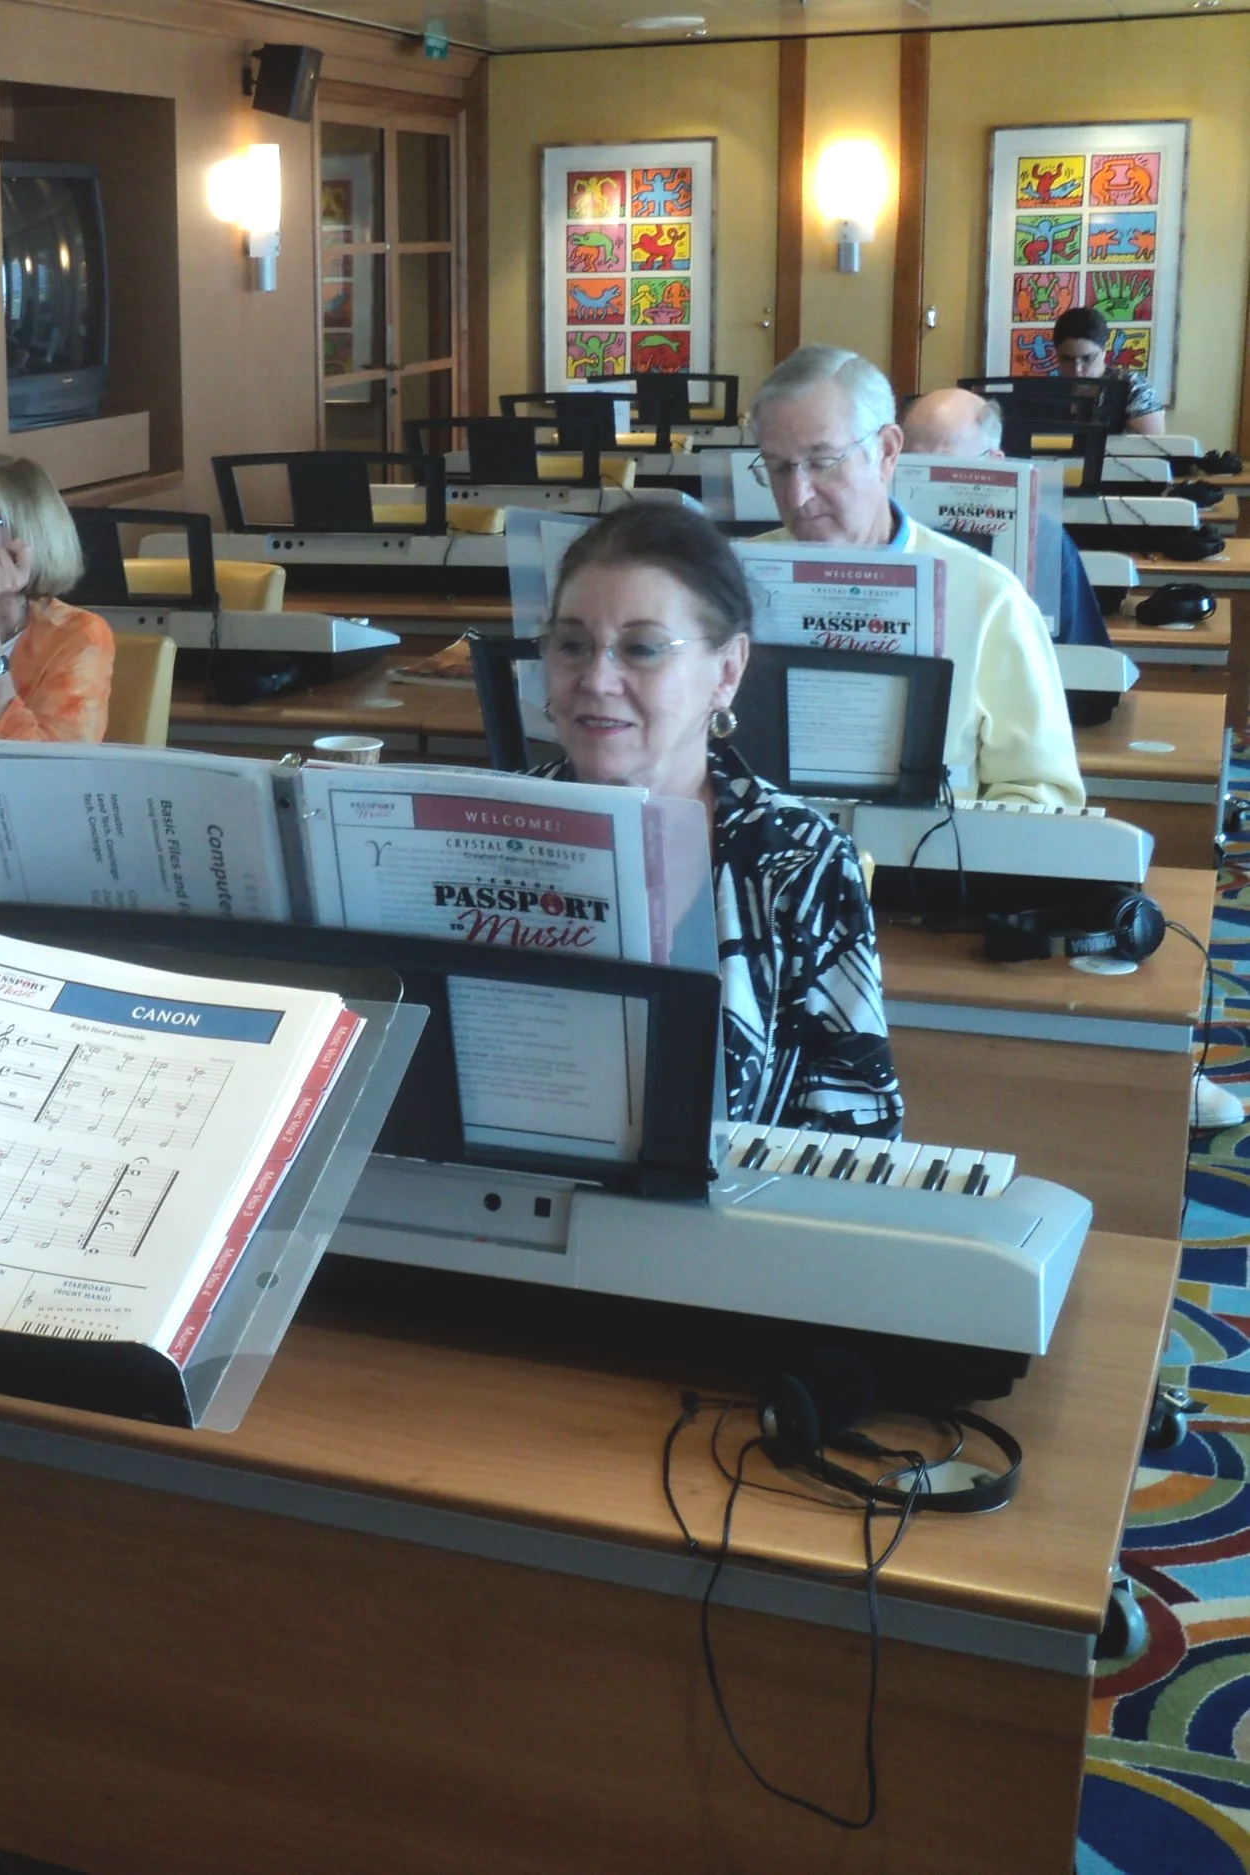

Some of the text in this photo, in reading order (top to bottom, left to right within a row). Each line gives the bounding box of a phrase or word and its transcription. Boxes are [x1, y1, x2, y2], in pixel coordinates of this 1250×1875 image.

[938, 506, 1017, 520] PASSPORT
[823, 569, 885, 580] WELCOME!
[802, 616, 911, 635] PASSPORT
[816, 631, 903, 654] Music
[160, 799, 176, 836] Basic
[464, 811, 562, 833] WELCOME!
[167, 838, 182, 871] Files
[445, 838, 502, 851] CRYSTAL
[529, 845, 587, 863] CRUISES
[207, 824, 233, 917] Computer
[172, 872, 189, 899] and
[433, 883, 609, 923] PASSPORT
[460, 908, 596, 949] Music
[131, 1006, 202, 1028] CANON
[70, 1022, 146, 1041] Right Hand Ensemble
[329, 1026, 348, 1048] Music
[322, 1048, 338, 1063] Visa
[293, 1097, 312, 1119] Music
[285, 1120, 302, 1135] Visa
[255, 1170, 274, 1192] Music
[246, 1194, 263, 1209] Visa
[214, 1248, 235, 1271] Music
[63, 1280, 111, 1293] STARBOARD
[205, 1272, 222, 1289] Visa
[53, 1287, 112, 1303] (RIGHT HAND)
[174, 1326, 196, 1350] Music
